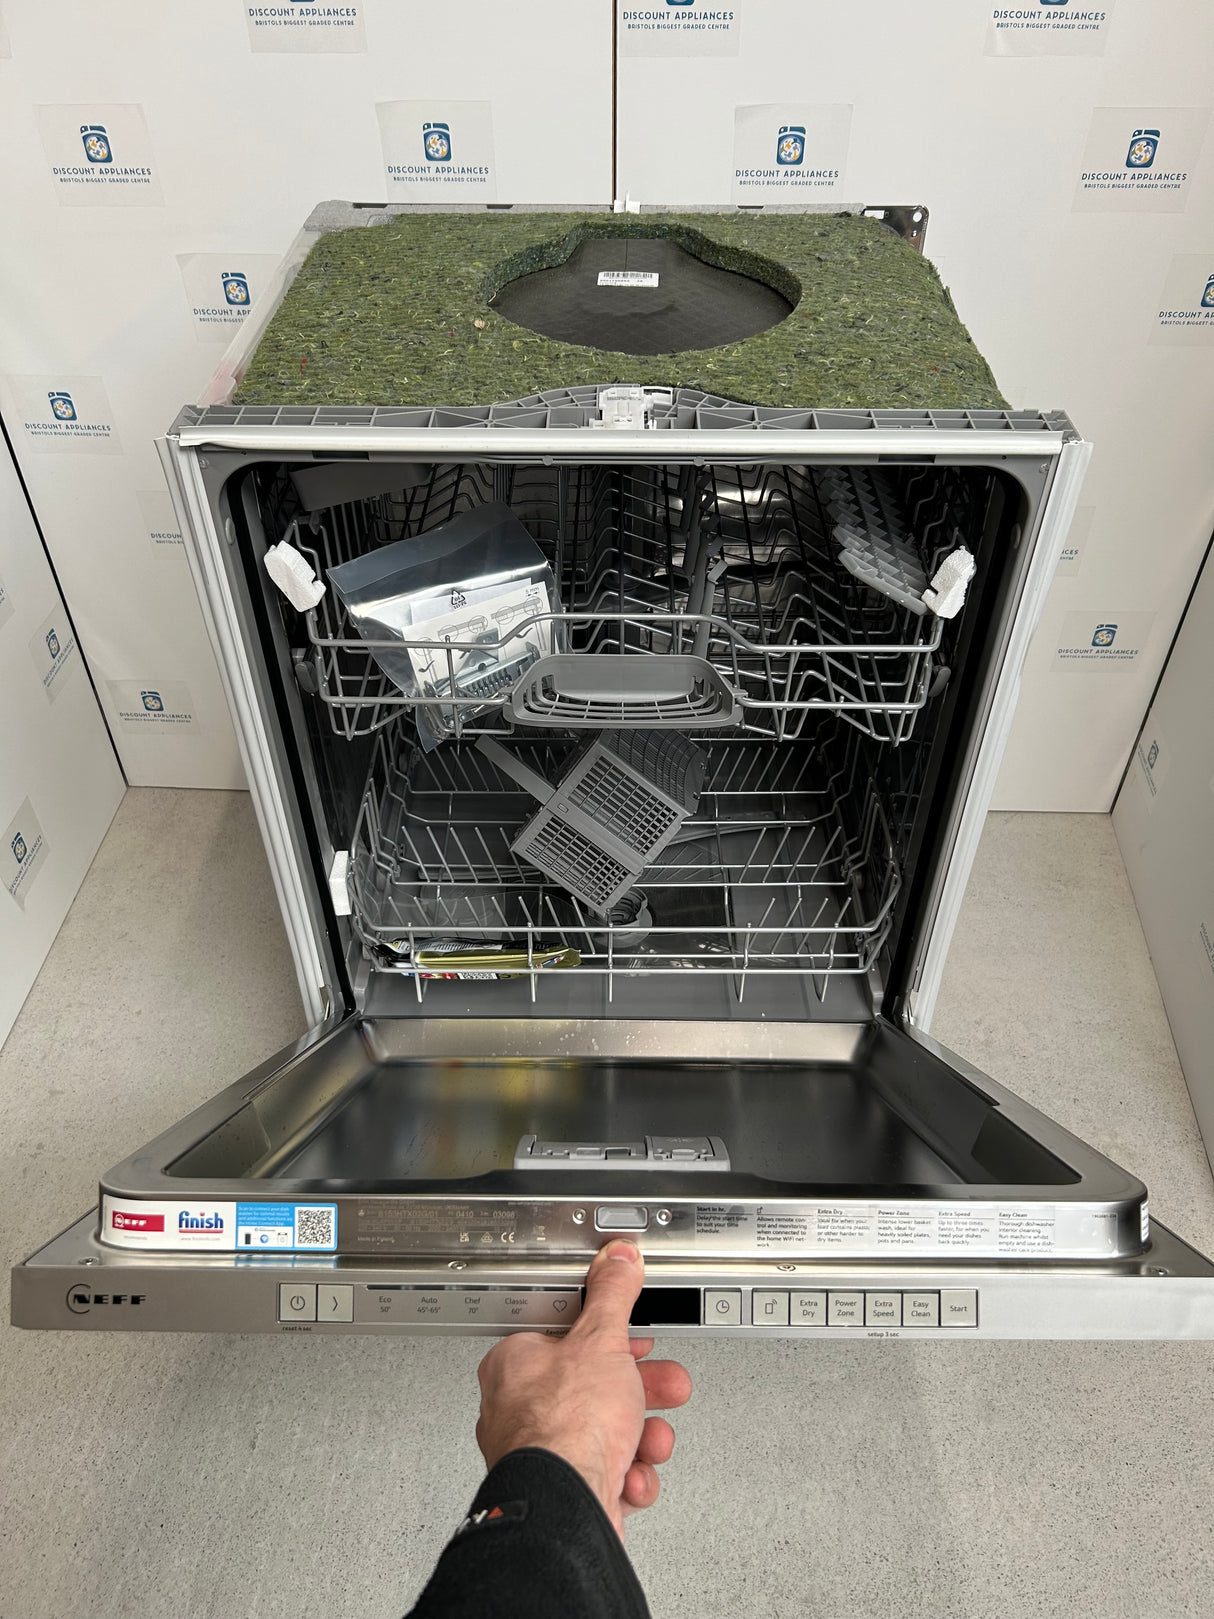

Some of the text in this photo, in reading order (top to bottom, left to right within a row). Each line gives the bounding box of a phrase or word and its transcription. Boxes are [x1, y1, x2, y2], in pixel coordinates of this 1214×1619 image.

[249, 8, 357, 16] DISCOUNT APPLIANCES
[623, 12, 734, 20] DISCOUNT APPLIANCES
[993, 10, 1106, 20] DISCOUNT APPLIANCES
[388, 166, 489, 174] DISCOUNT APPLIANCES
[784, 170, 839, 178] APPLIANCES
[1081, 173, 1188, 181] DISCOUNT APPLIANCES
[179, 1210, 224, 1228] finish
[501, 1232, 514, 1243] CE
[913, 1301, 929, 1309] Easy
[803, 1310, 815, 1318] Dry
[873, 1310, 894, 1318] Speed
